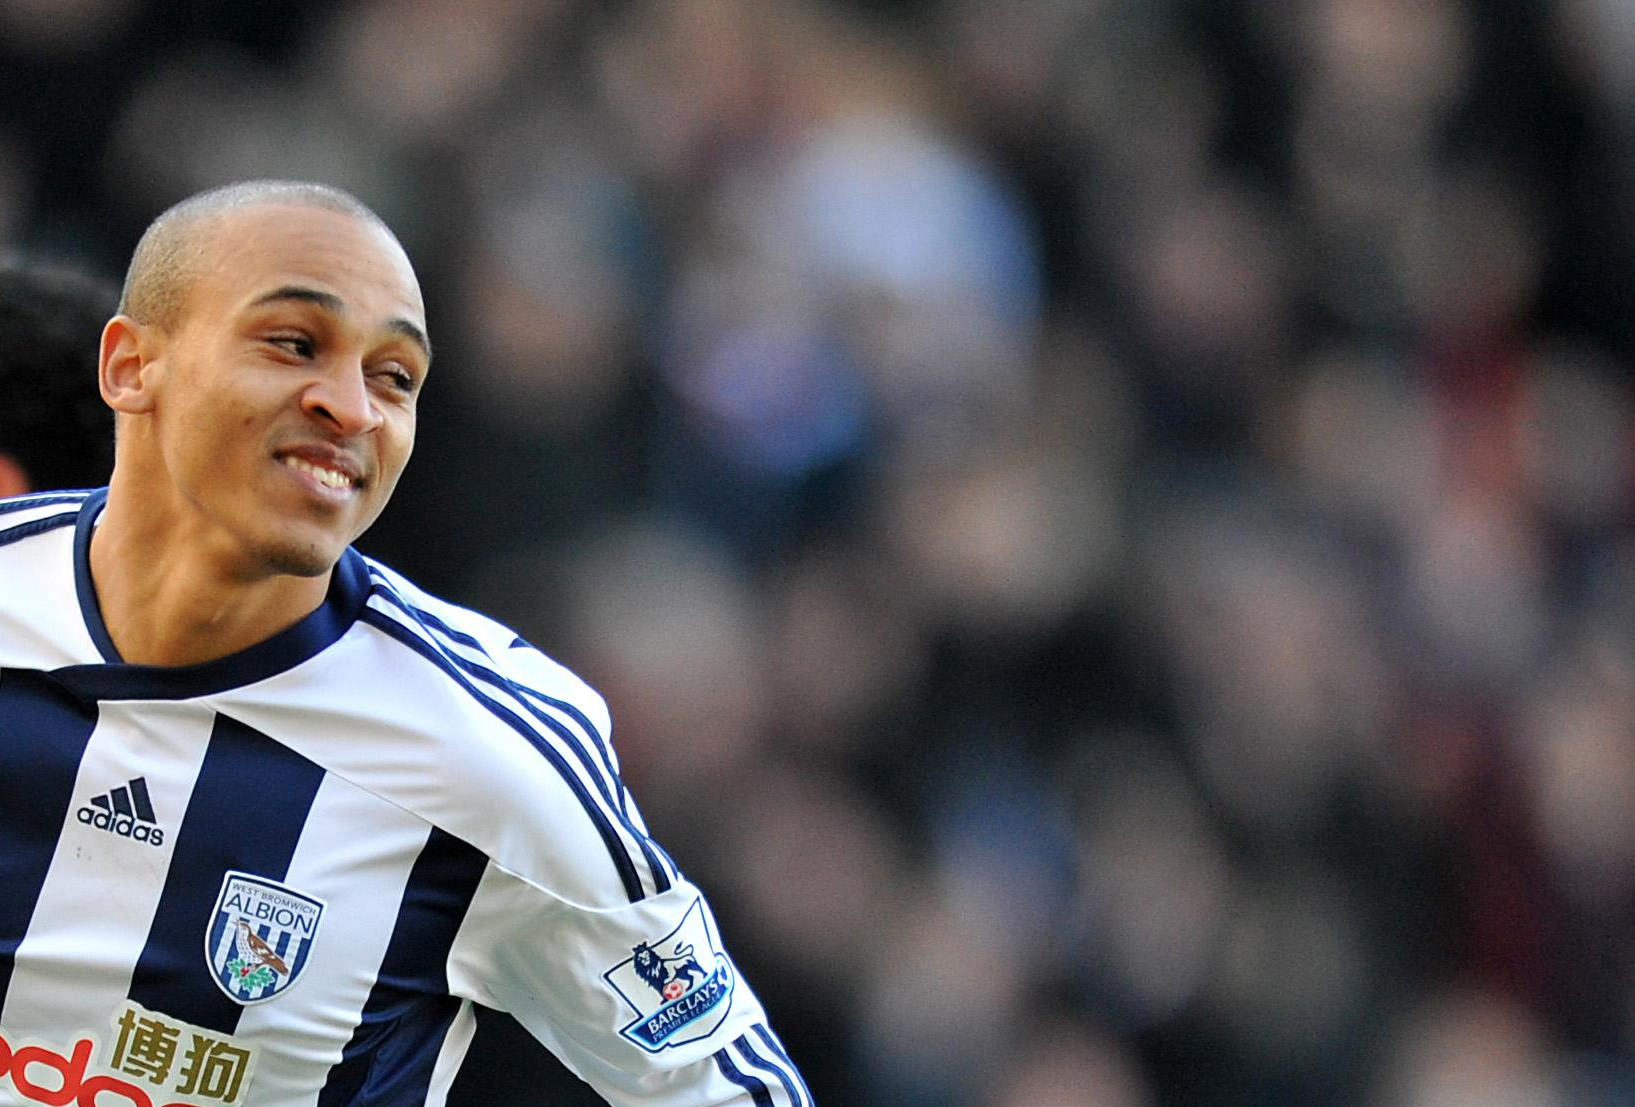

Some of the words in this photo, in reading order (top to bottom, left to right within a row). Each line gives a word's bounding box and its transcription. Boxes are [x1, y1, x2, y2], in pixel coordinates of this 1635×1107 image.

[77, 805, 164, 847] adidas
[225, 892, 314, 934] ALBION
[232, 881, 259, 896] WEST
[261, 891, 317, 915] BROMWICH
[647, 978, 718, 1034] BARCLAYS
[109, 1008, 252, 1103] 博狗
